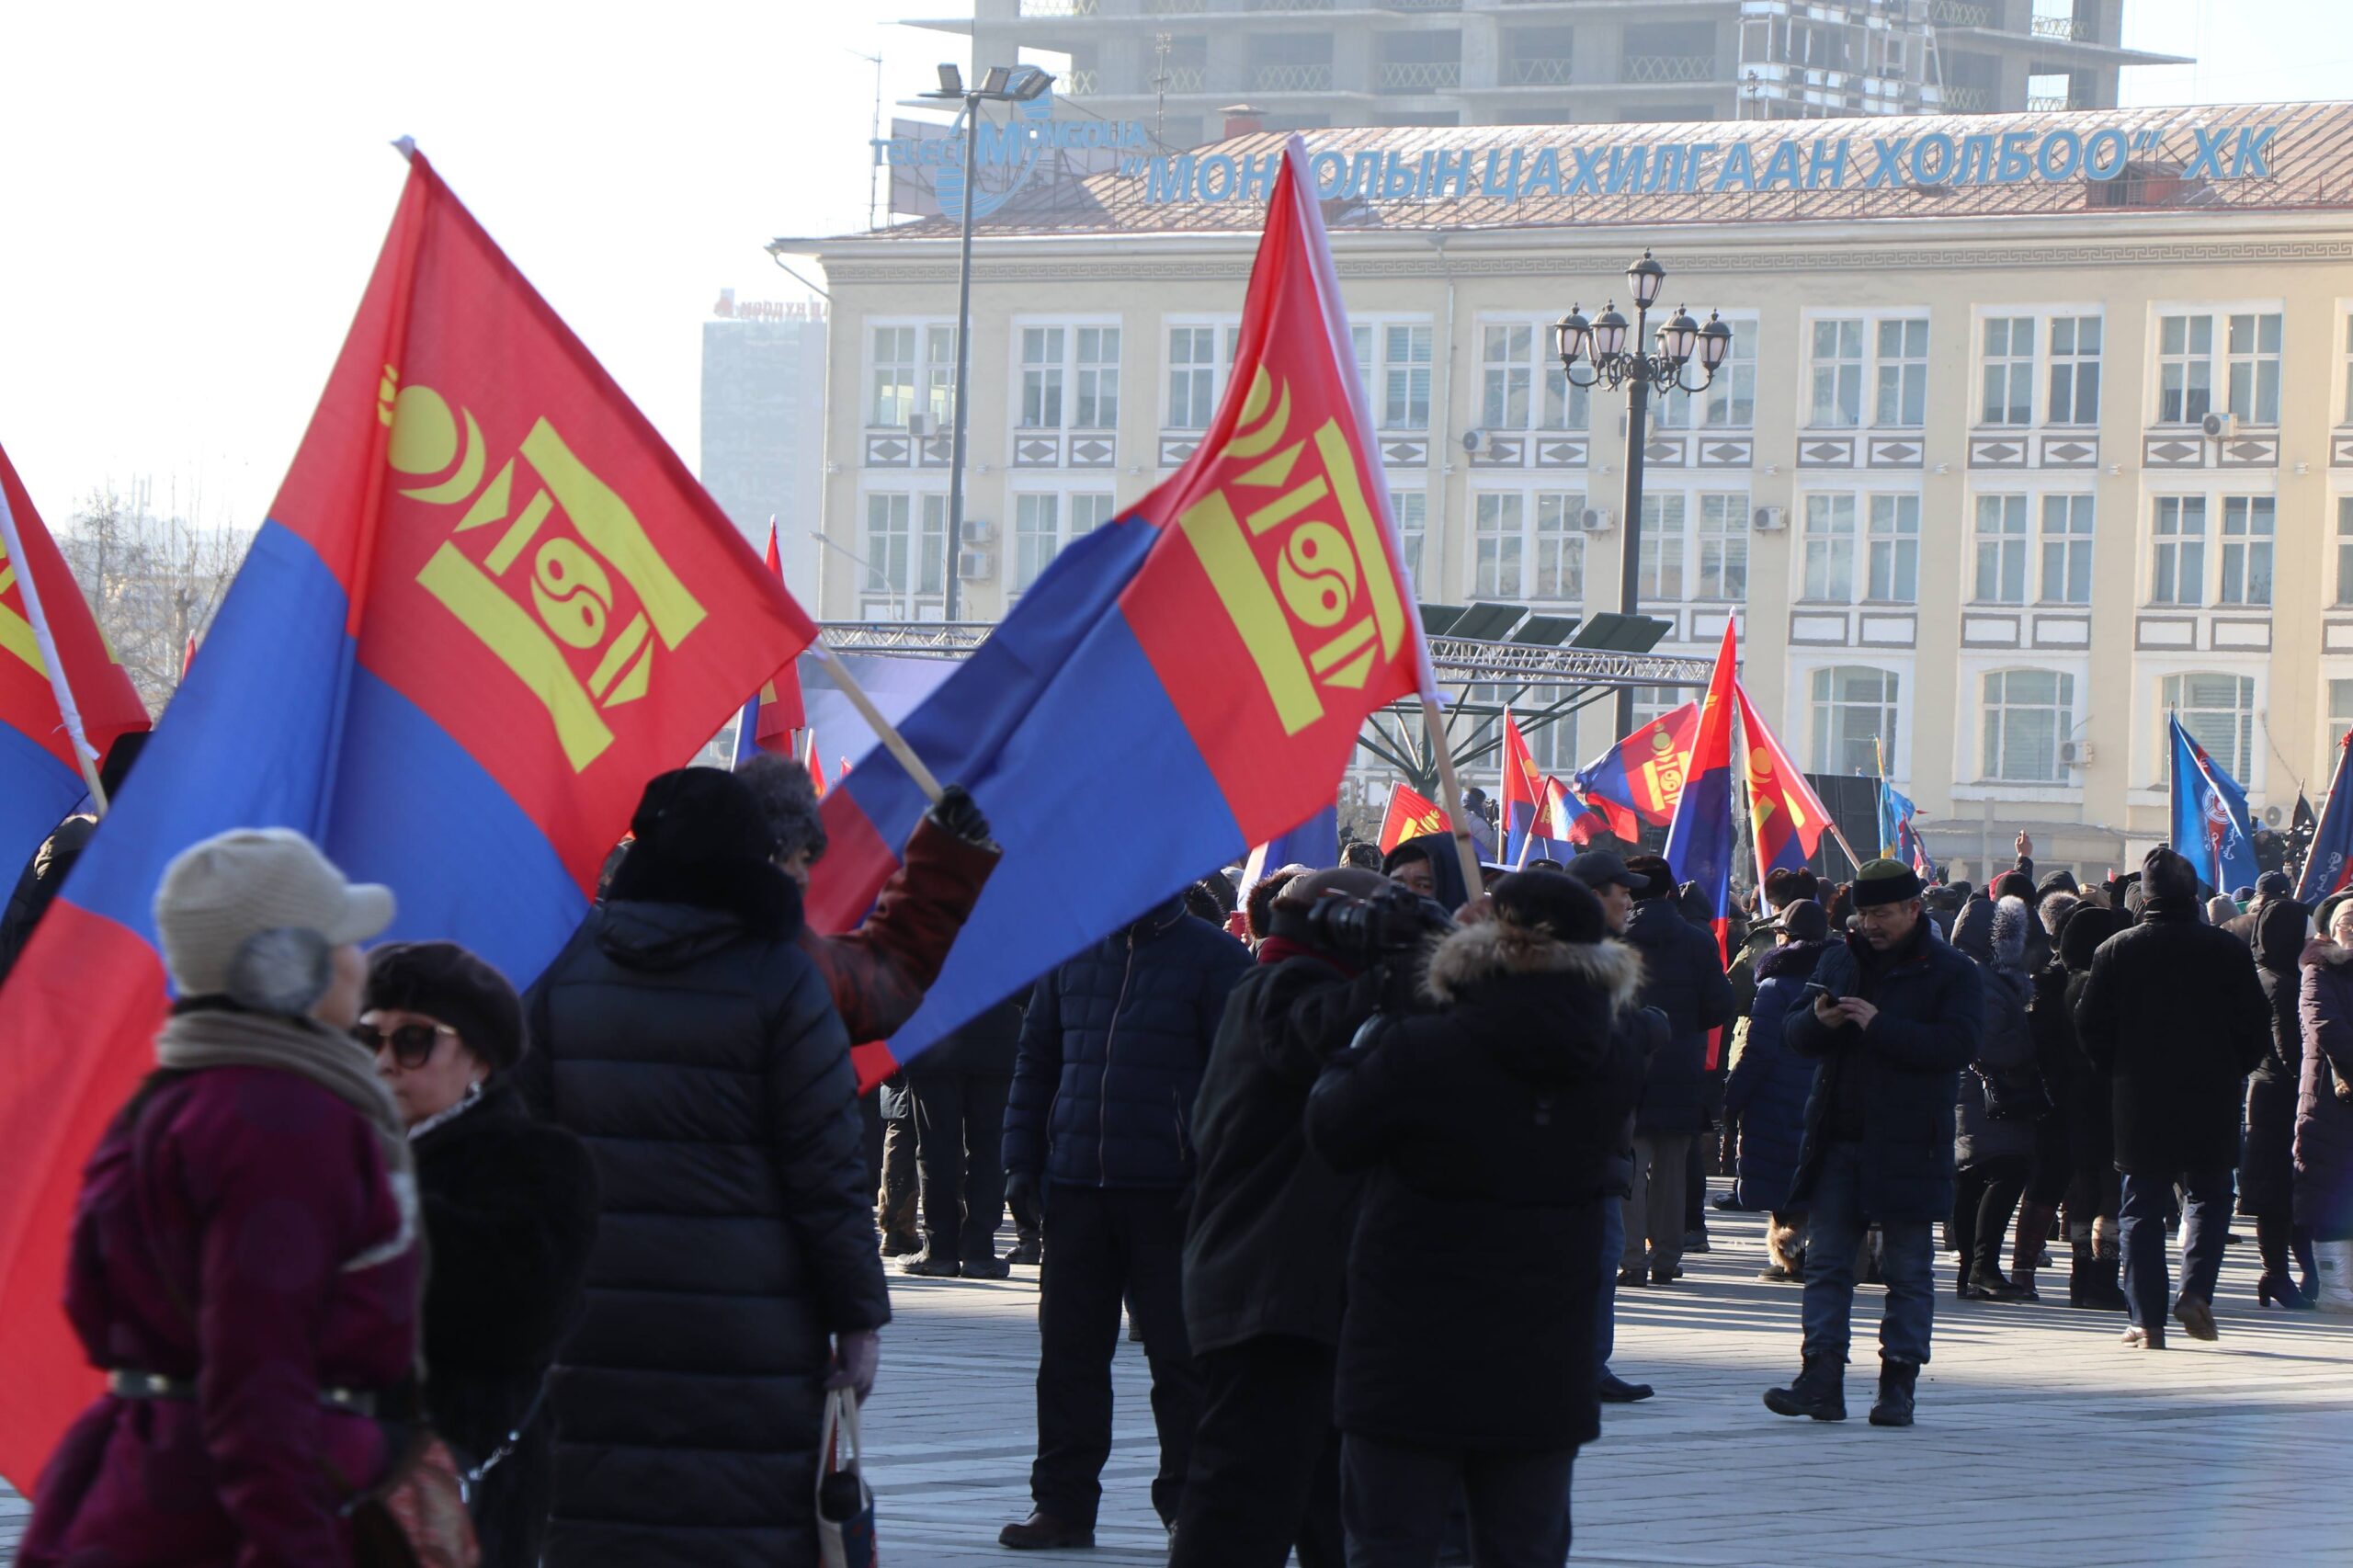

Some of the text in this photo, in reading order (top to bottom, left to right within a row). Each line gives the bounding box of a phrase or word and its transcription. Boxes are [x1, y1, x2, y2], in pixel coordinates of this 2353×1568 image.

[1119, 126, 2279, 205] "МОНОЛЫН ЦАХИЛГААН ХОЛБОО" ХК
